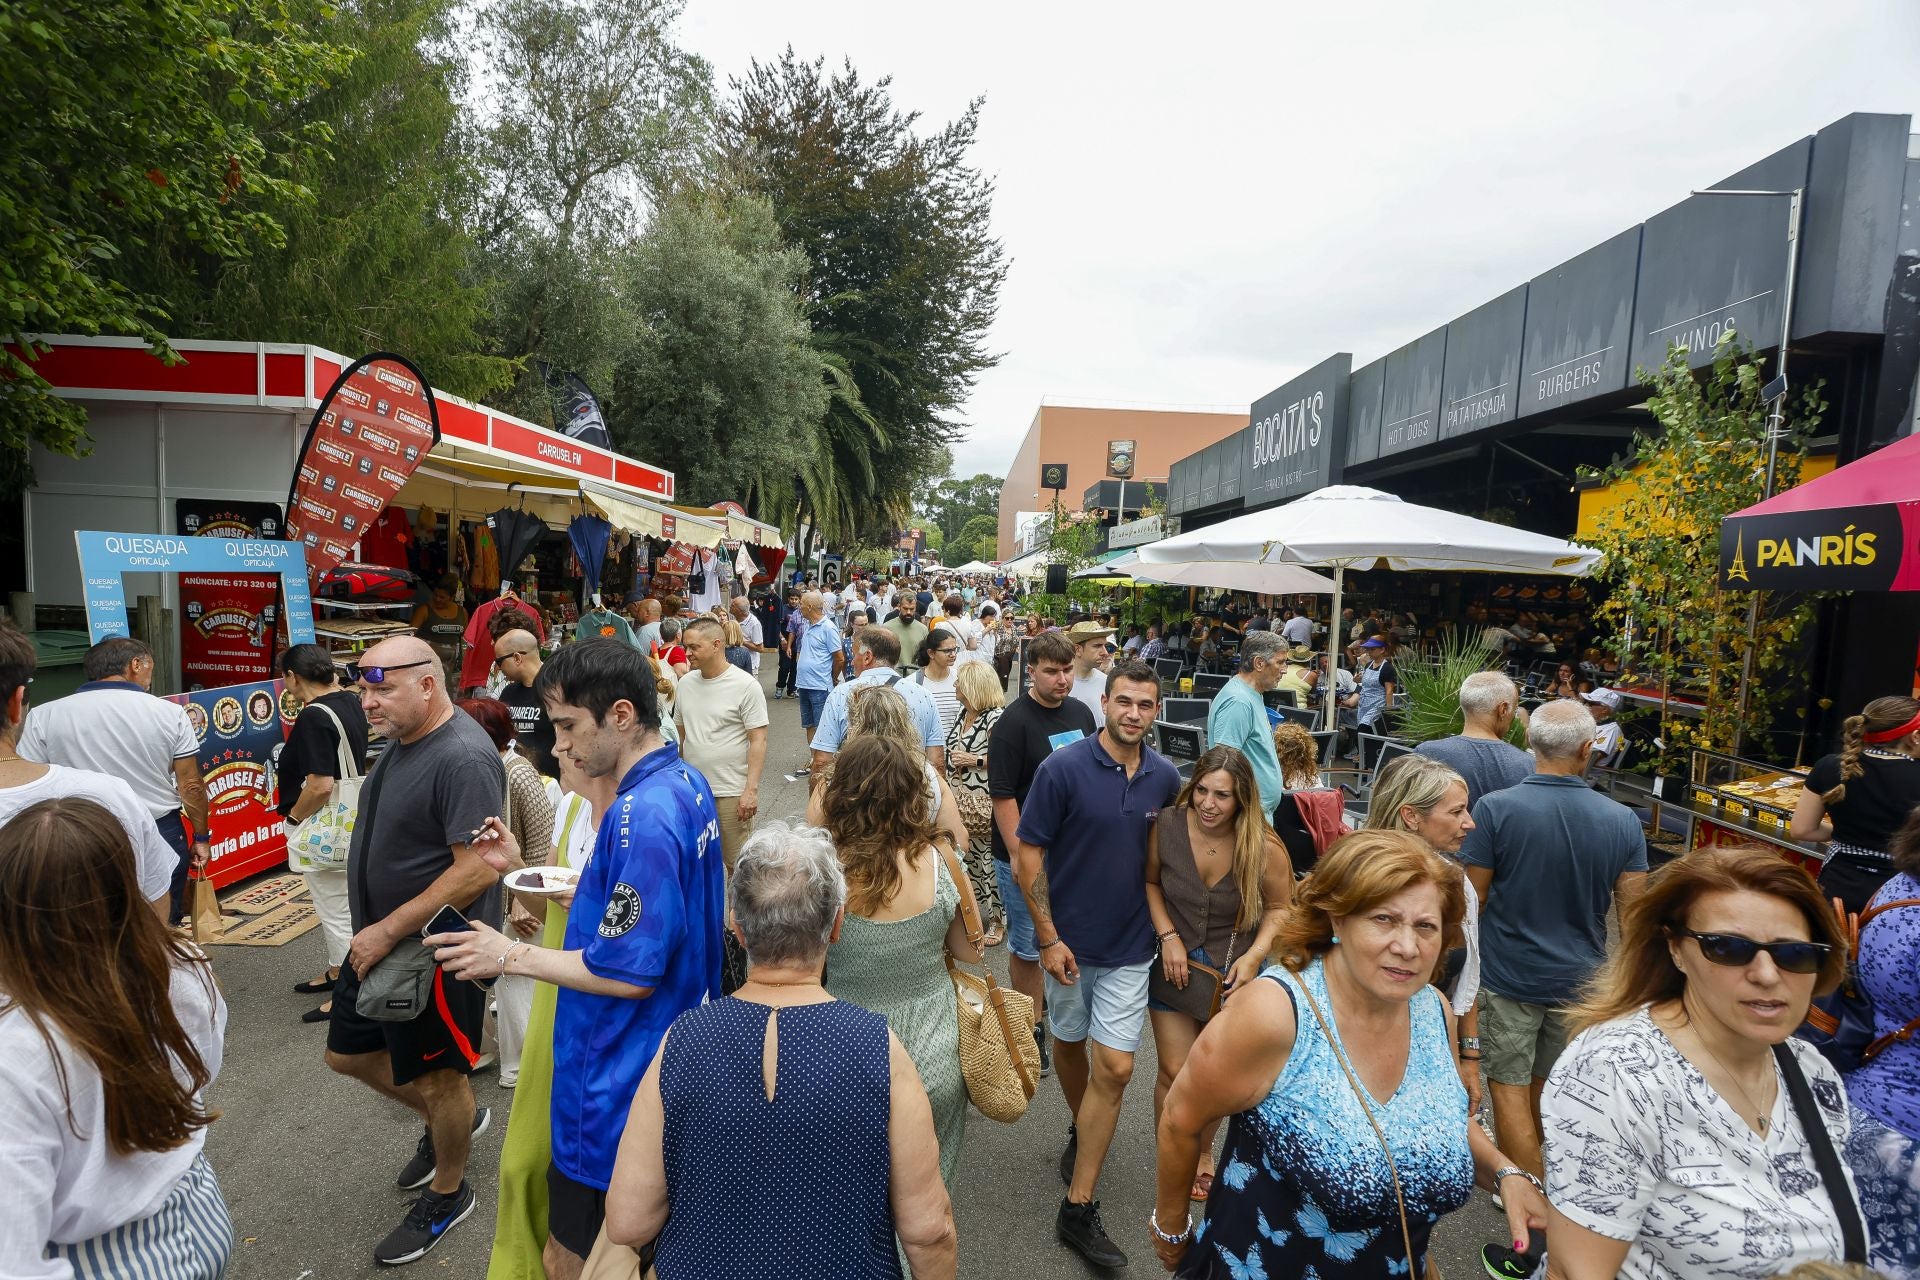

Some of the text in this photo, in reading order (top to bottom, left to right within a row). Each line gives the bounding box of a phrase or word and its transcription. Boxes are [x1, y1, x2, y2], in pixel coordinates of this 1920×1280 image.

[1538, 361, 1601, 400] BURGERS
[1447, 393, 1506, 428] PATATASADA
[1253, 391, 1324, 469] BOCATA'S
[1388, 420, 1429, 446] HOT DOGS
[538, 441, 582, 466] CARRUSEL FM
[185, 518, 200, 526] 94.1
[262, 522, 276, 530] 98.7
[105, 537, 188, 555] QUESADA
[225, 542, 288, 558] QUESADA
[1757, 524, 1877, 567] PANRÍS
[184, 577, 231, 587] ANÚNCIATE:
[233, 580, 248, 588] 673
[187, 604, 202, 613] 94.1
[94, 621, 125, 629] QUESADA
[203, 613, 247, 631] CARRUSEL
[187, 661, 267, 673] ANÚNCIATE: 673 320
[215, 799, 250, 815] ASTURIAS
[620, 803, 631, 848] OMEN
[239, 831, 255, 847] de
[256, 826, 270, 838] la
[614, 884, 632, 896] EAM
[600, 923, 623, 936] AZER
